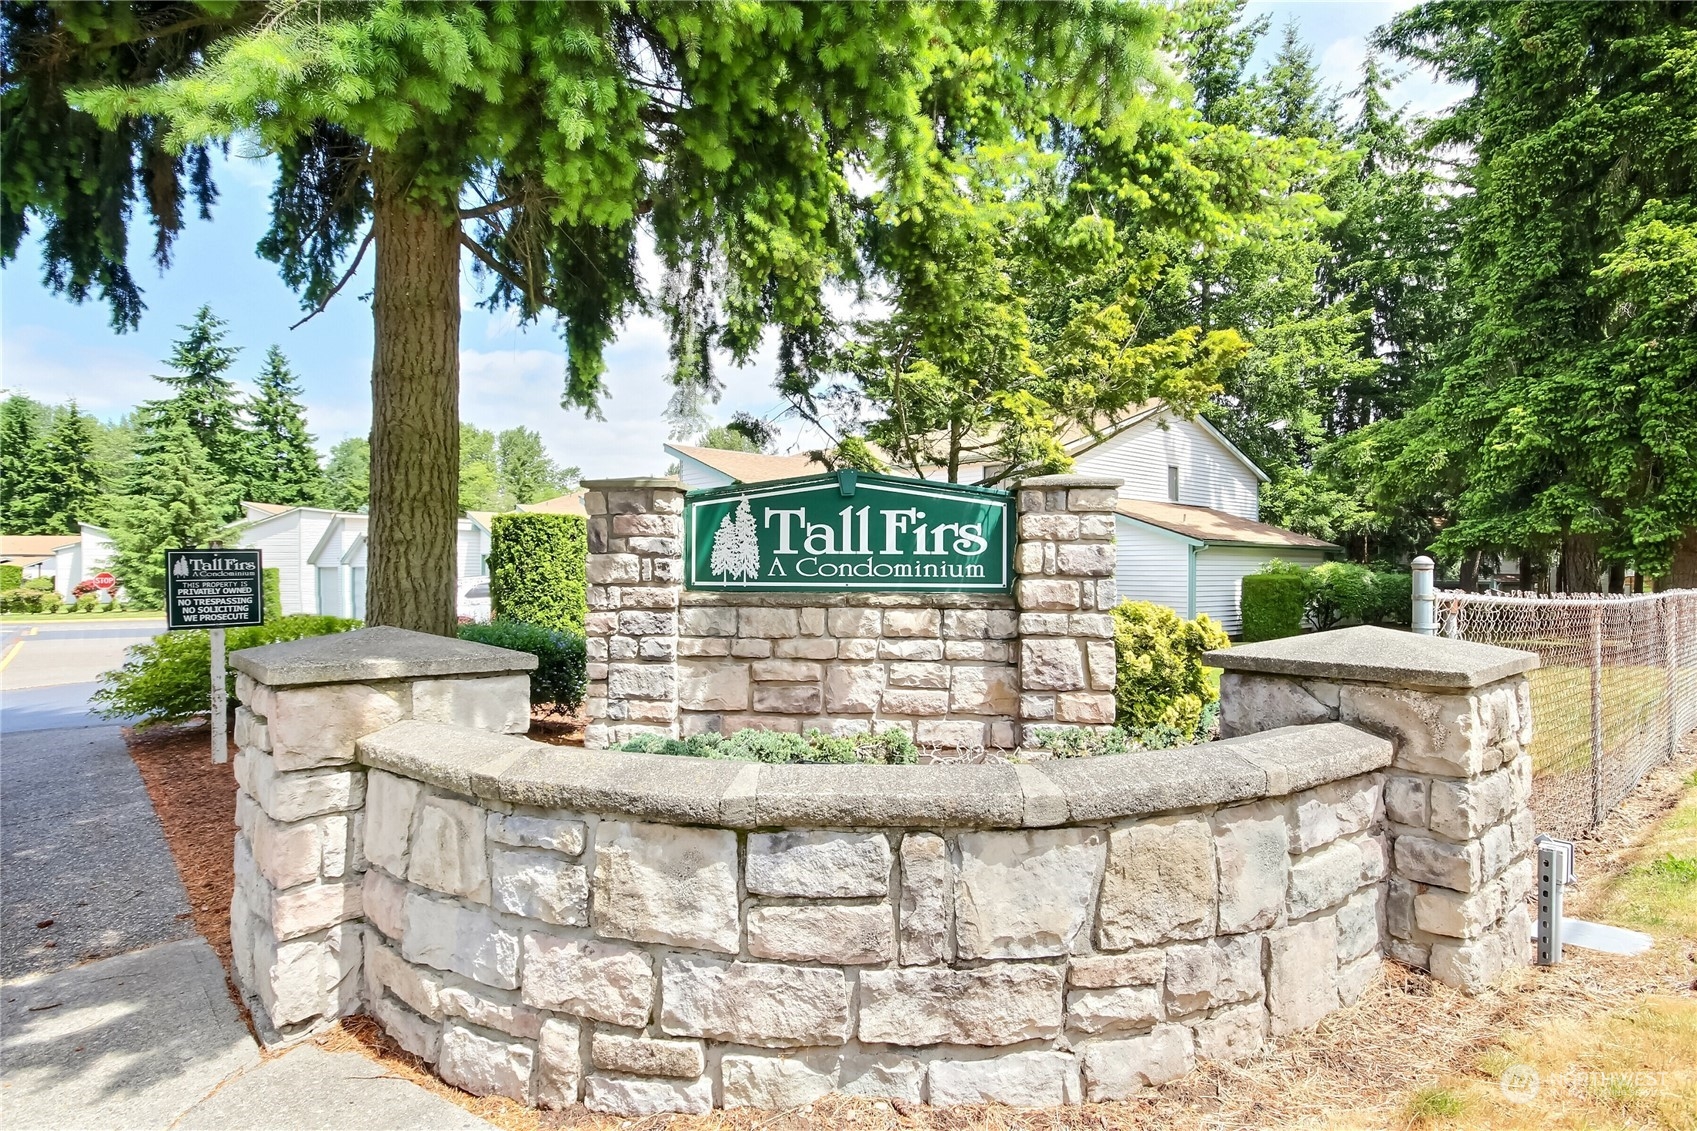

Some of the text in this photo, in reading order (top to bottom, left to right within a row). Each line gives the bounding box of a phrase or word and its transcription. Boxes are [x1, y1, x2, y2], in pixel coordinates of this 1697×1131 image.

[764, 505, 988, 556] Tall Firs
[189, 558, 256, 571] Tall Firs
[768, 557, 985, 578] A Condominium
[193, 597, 253, 606] TRESPASSING
[197, 605, 249, 614] SOLICITING
[183, 613, 249, 622] WE PROSECUTE
